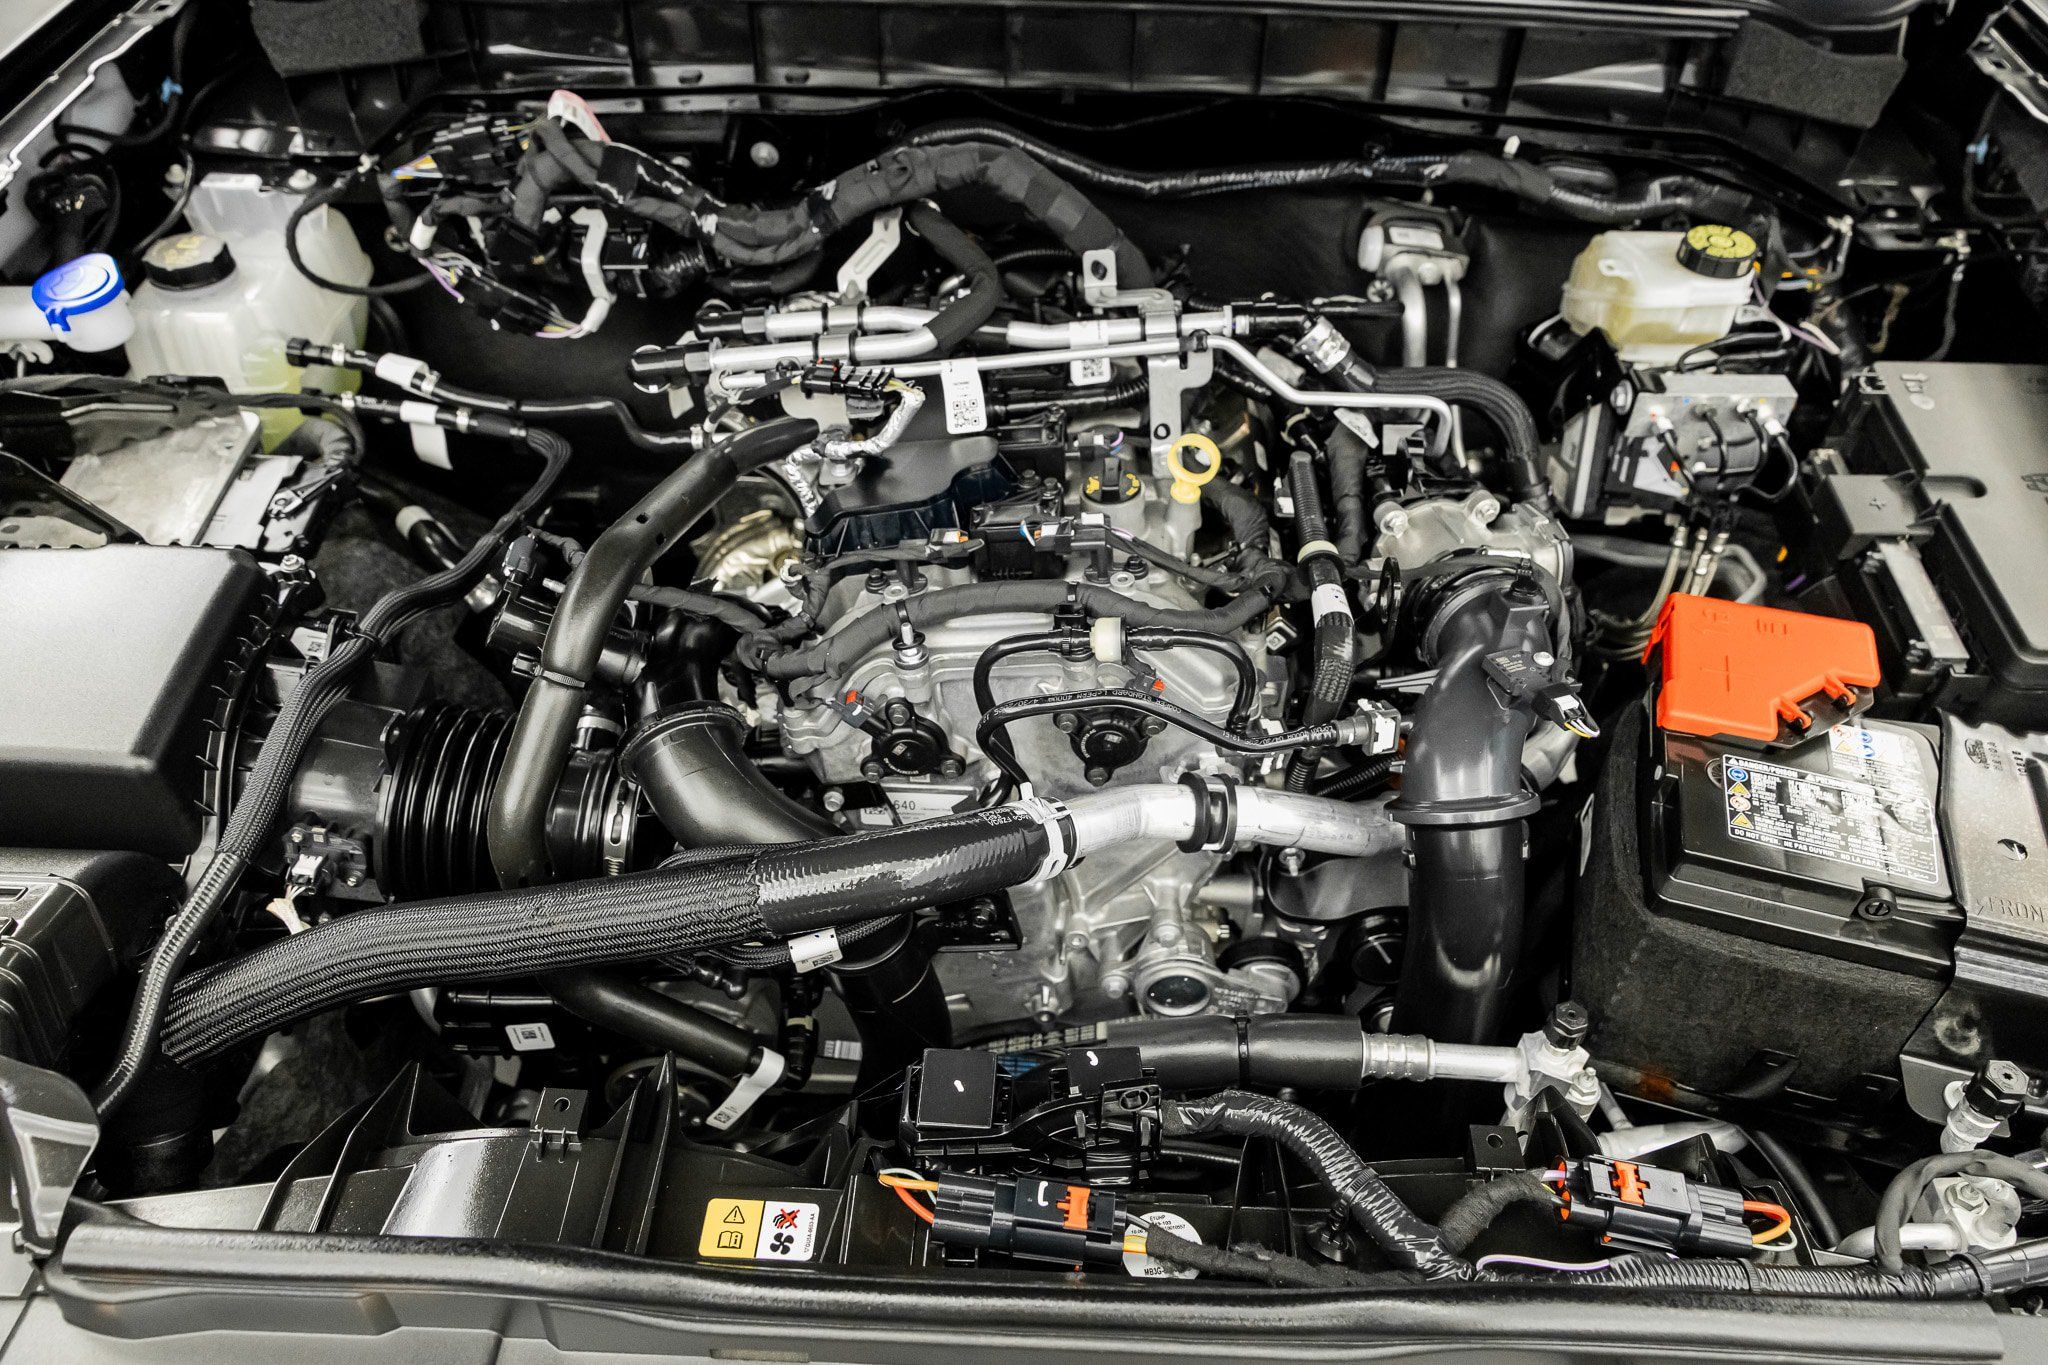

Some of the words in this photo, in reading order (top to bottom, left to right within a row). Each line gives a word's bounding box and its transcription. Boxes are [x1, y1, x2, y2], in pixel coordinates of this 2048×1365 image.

[1734, 828, 1745, 836] DO
[1745, 830, 1759, 840] NOT
[1988, 897, 2047, 923] FRON
